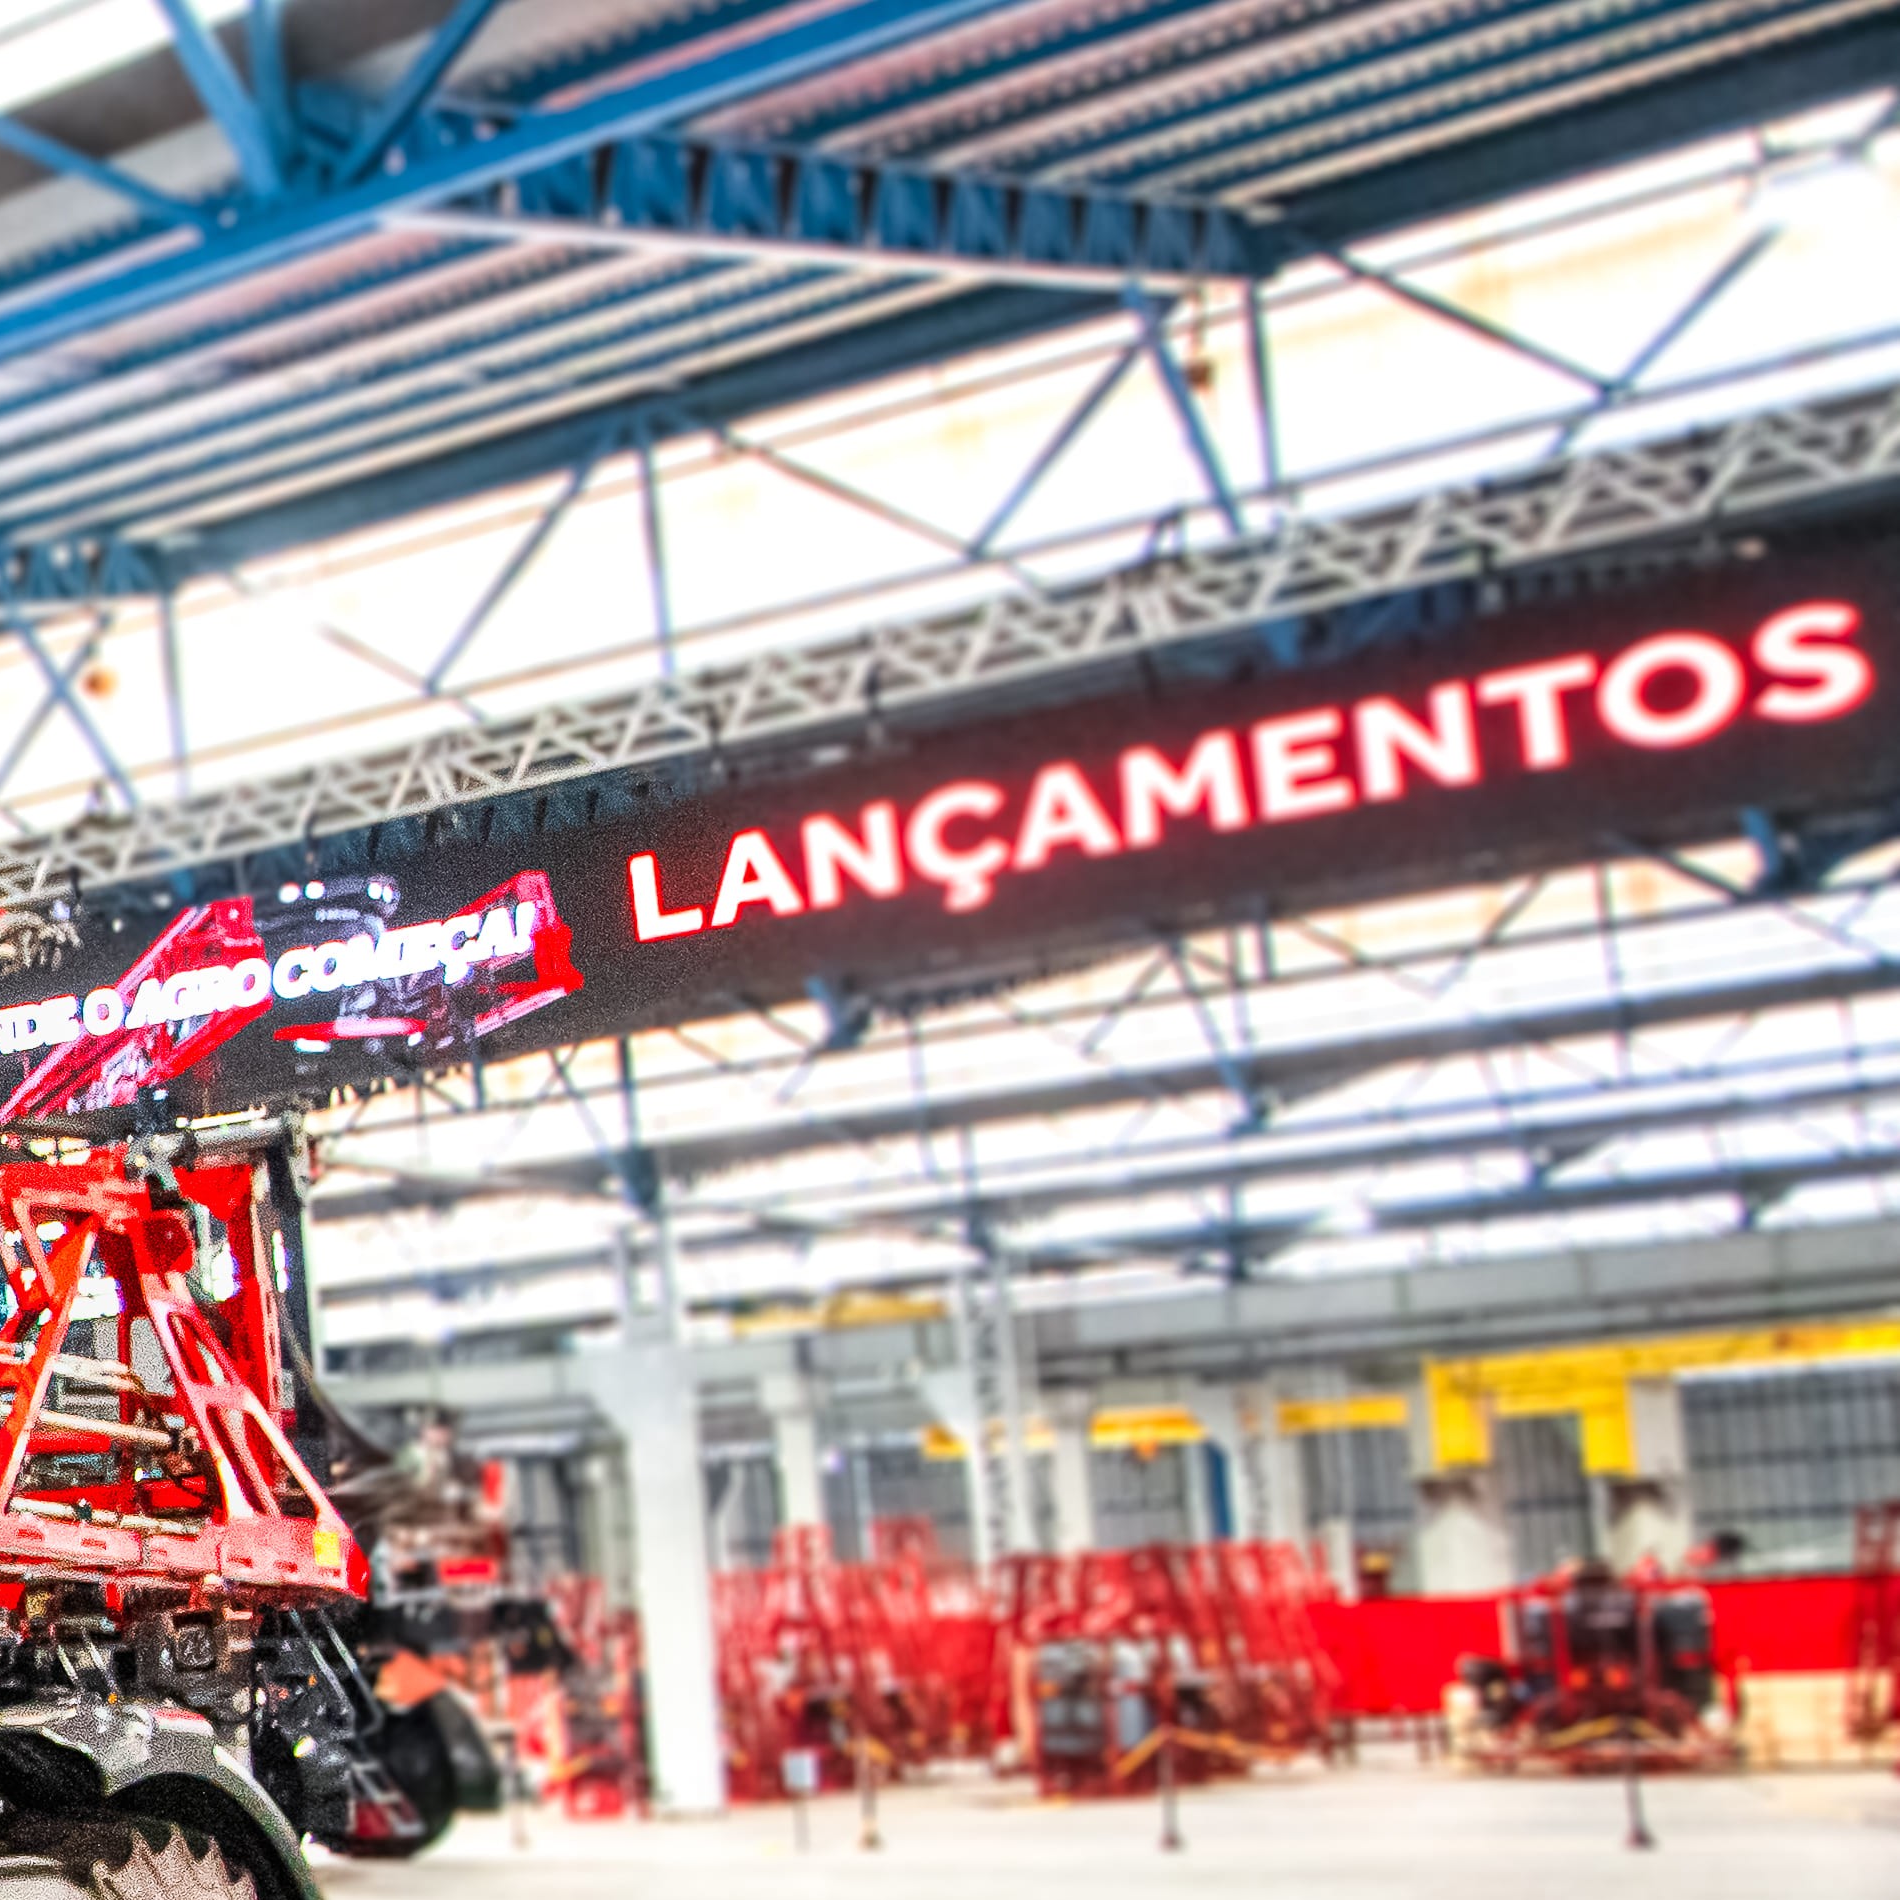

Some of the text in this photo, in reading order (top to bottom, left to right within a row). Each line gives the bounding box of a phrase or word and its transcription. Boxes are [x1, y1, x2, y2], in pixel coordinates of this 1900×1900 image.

[628, 603, 1872, 943] LANÇAMENTOS
[82, 986, 125, 1037] O
[123, 957, 271, 1030] AGRO
